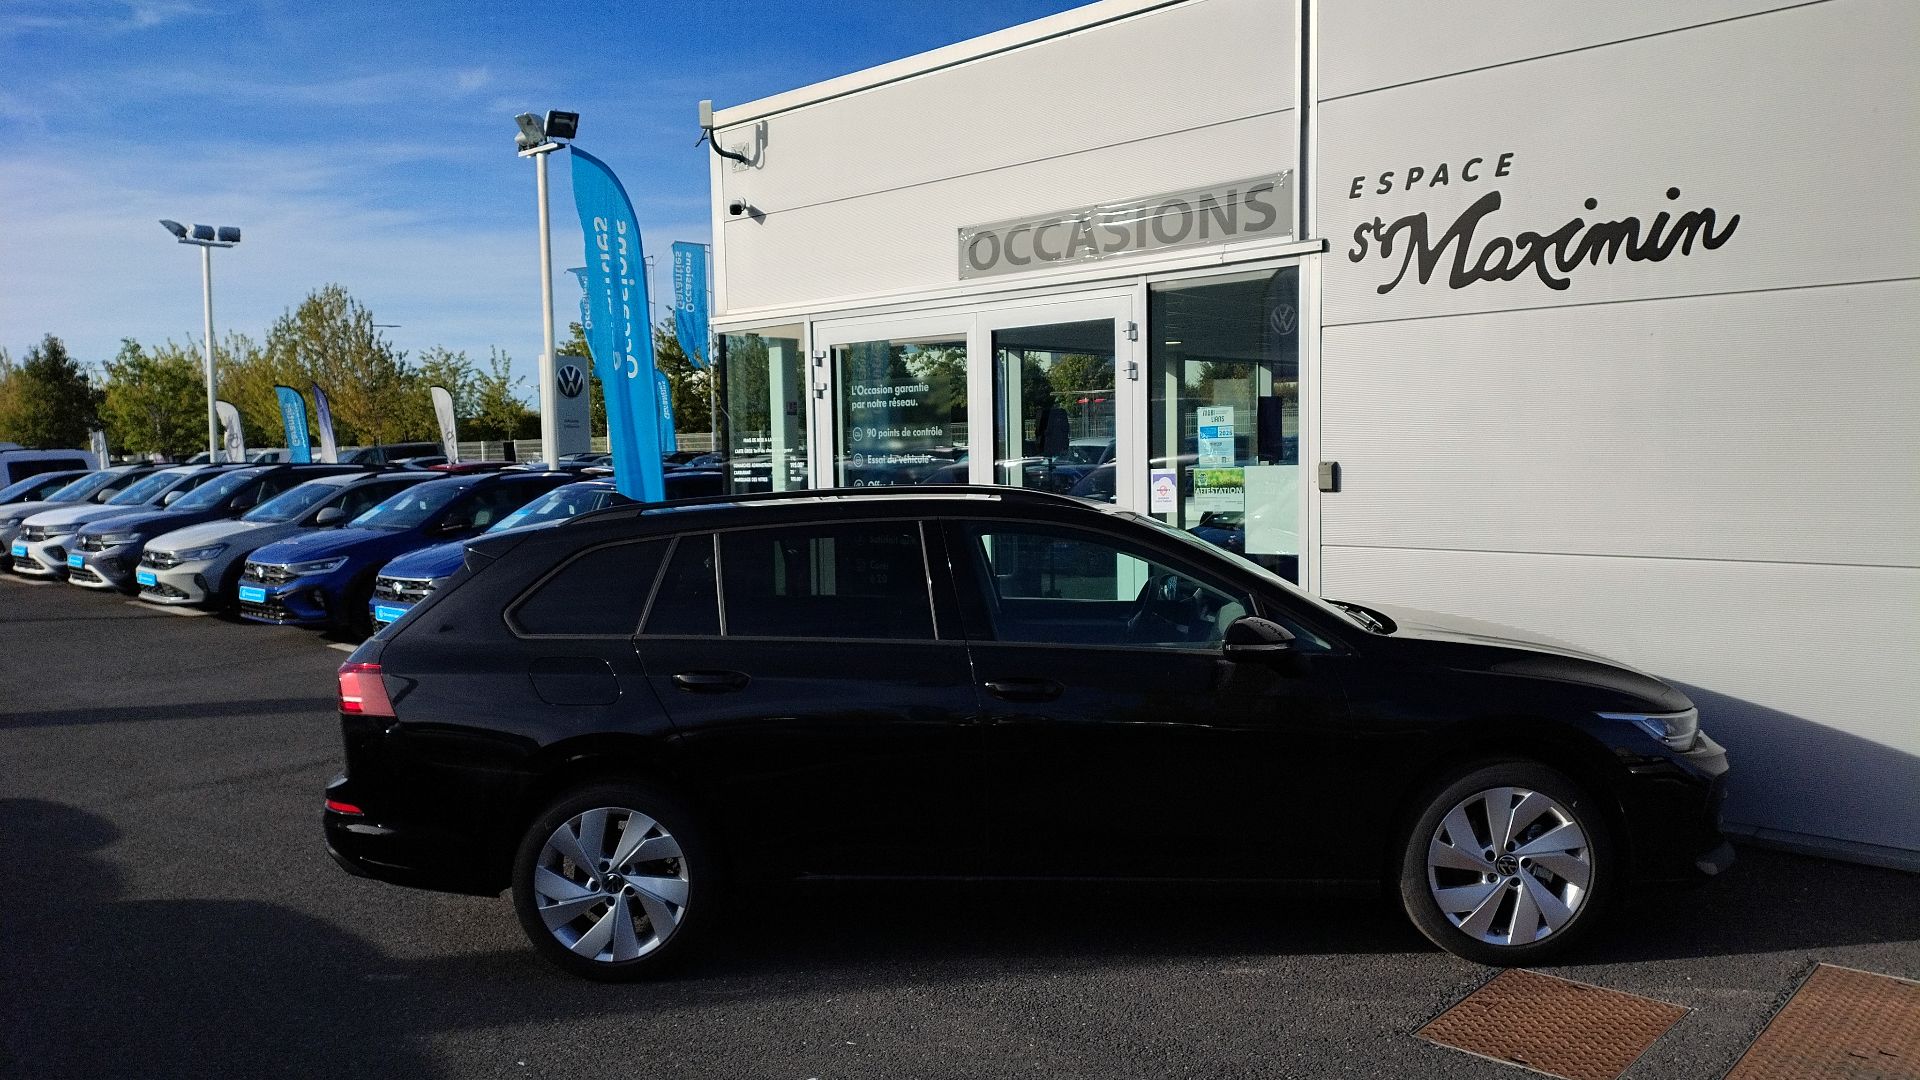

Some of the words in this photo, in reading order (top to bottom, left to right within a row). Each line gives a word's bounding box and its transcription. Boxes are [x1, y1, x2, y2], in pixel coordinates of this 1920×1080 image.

[1349, 152, 1514, 199] ESPACE
[968, 182, 1277, 271] OCCASIONS
[1376, 187, 1741, 295] Maximin
[851, 384, 893, 396] L'Occasion
[894, 382, 930, 396] garantie
[851, 401, 865, 411] par
[866, 398, 887, 408] notre
[888, 397, 919, 407] réseau.
[866, 428, 877, 438] 90
[878, 427, 900, 439] points
[901, 426, 912, 437] de
[912, 425, 943, 437] contrôle
[867, 454, 886, 464] Essai
[887, 454, 897, 464] du
